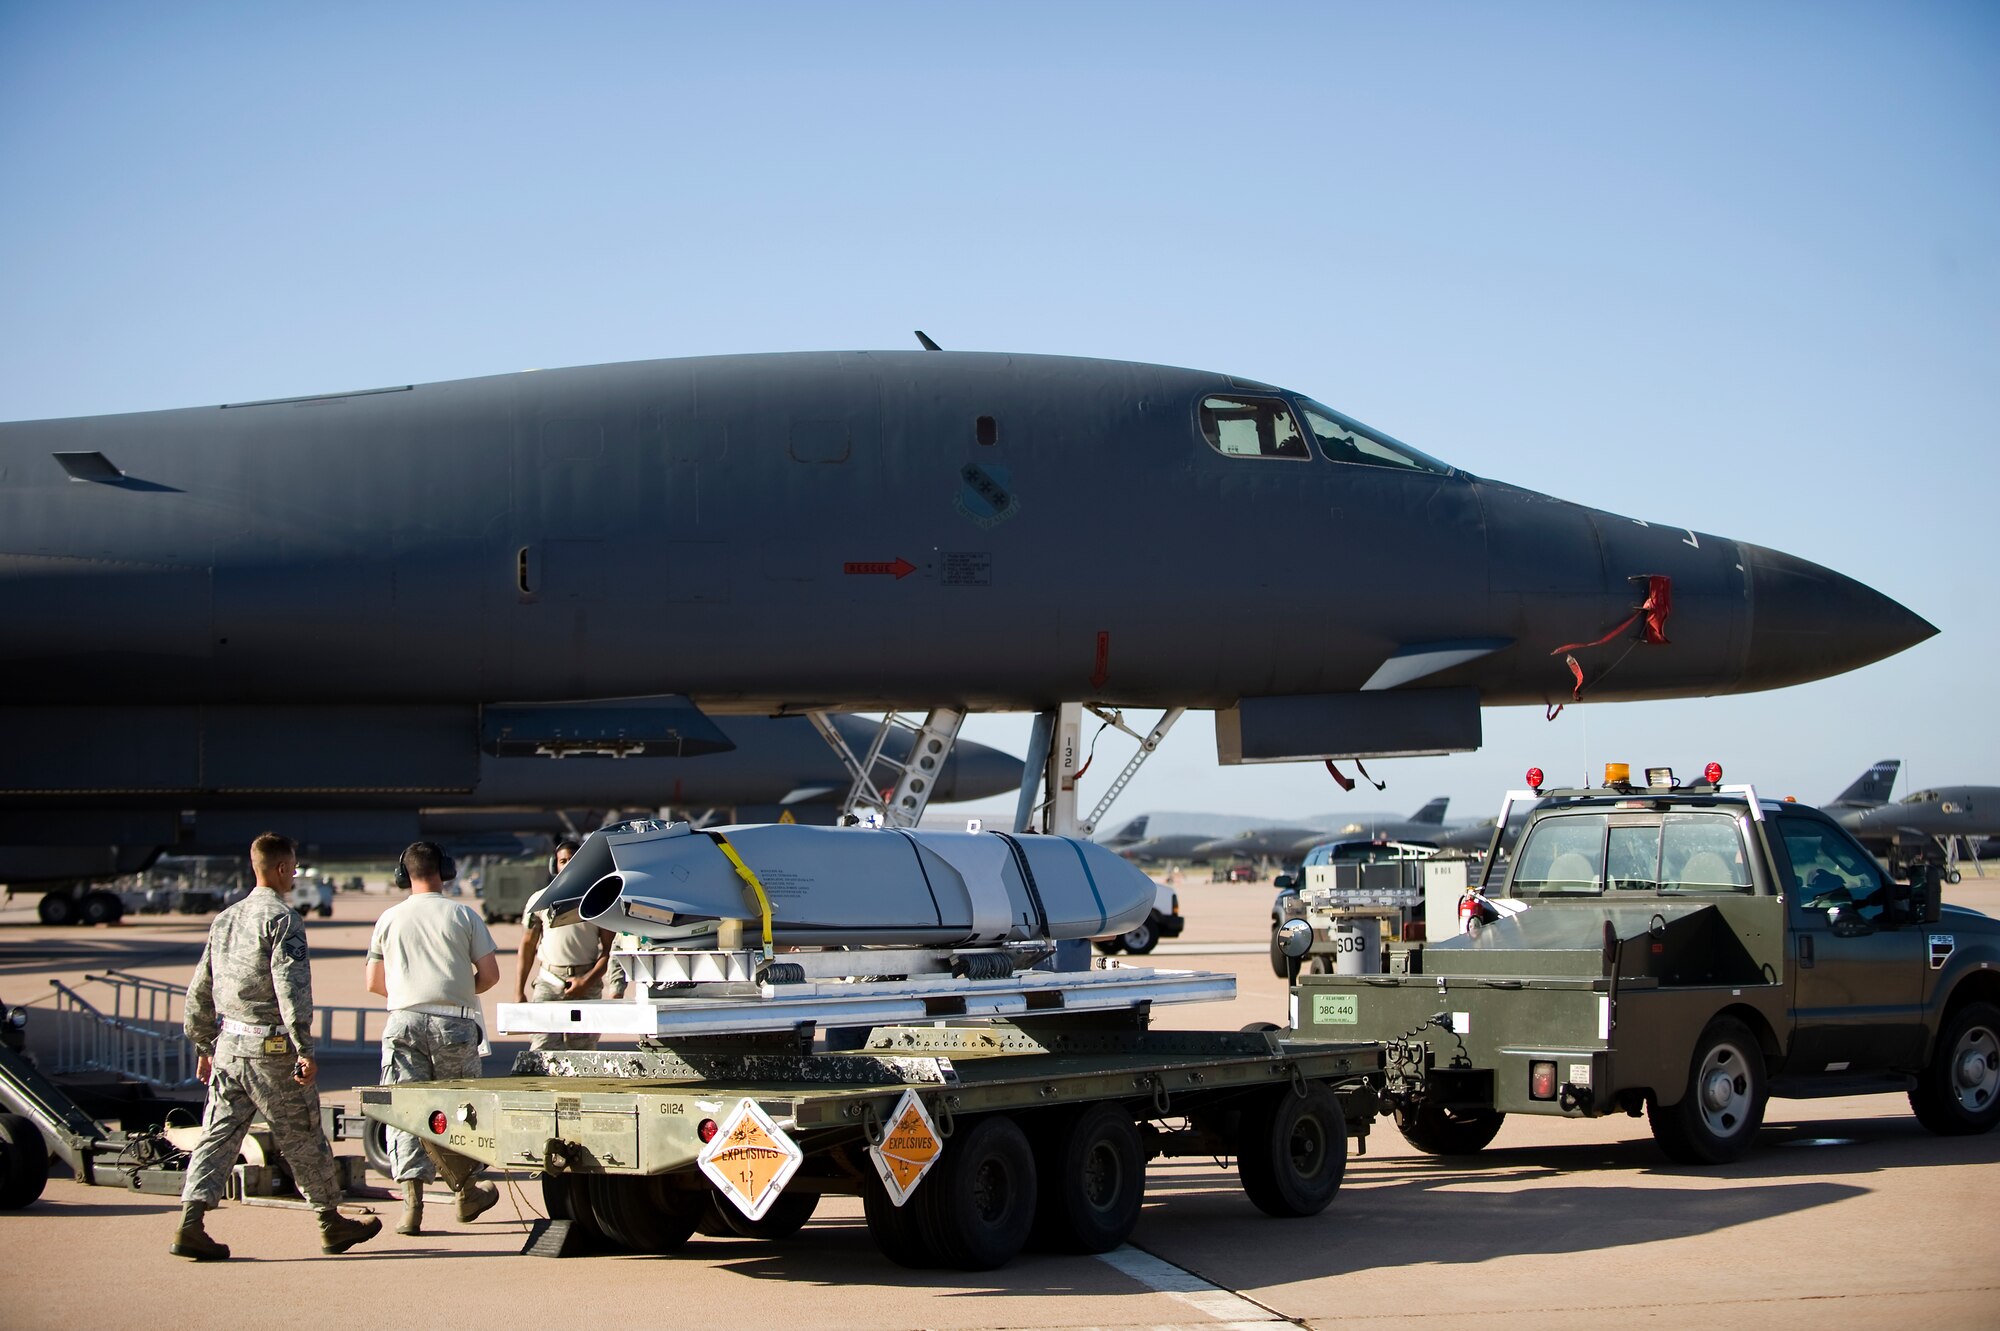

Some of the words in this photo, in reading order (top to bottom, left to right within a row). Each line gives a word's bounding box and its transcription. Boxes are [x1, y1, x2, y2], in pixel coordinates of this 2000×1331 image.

[849, 564, 890, 573] RESCUE
[1064, 737, 1073, 767] 132
[1337, 1006, 1354, 1015] 440
[660, 1103, 684, 1115] G1124
[449, 1134, 466, 1146] ACC
[478, 1136, 495, 1149] DYE
[889, 1136, 933, 1150] EXPLOSIVES
[721, 1147, 779, 1161] EXPLOSIVES
